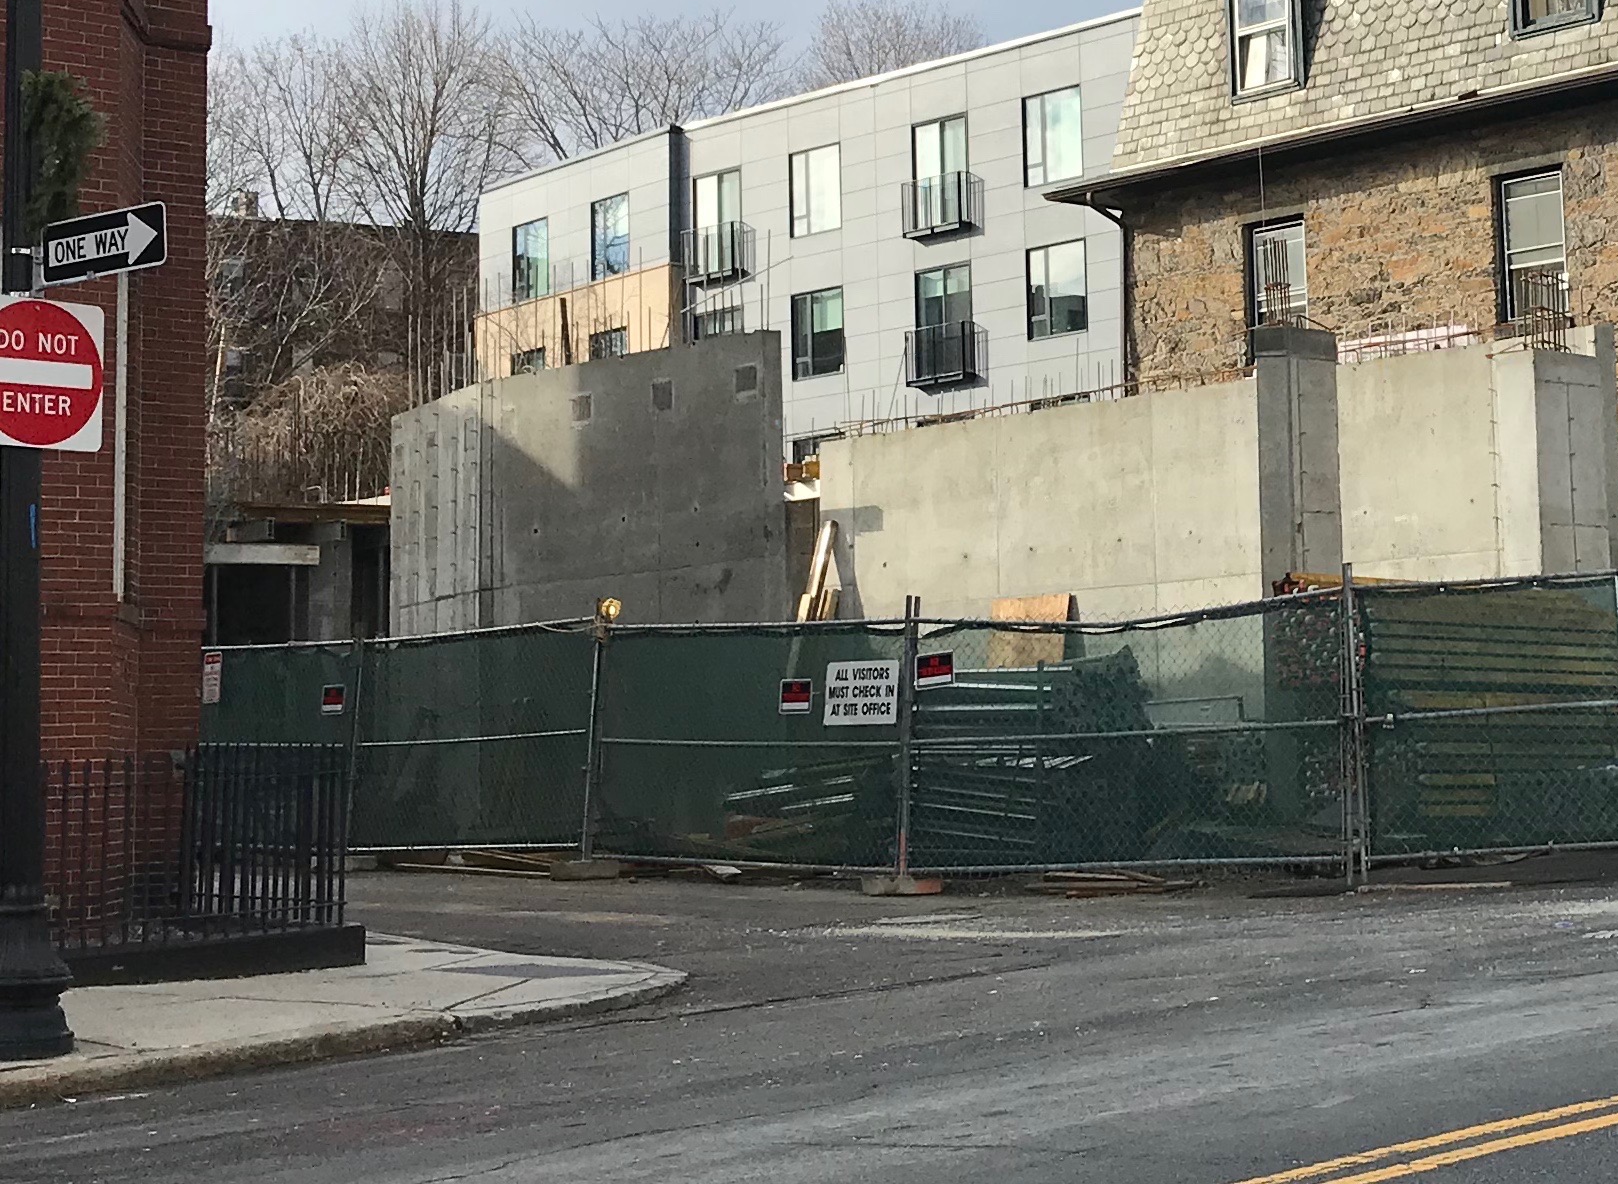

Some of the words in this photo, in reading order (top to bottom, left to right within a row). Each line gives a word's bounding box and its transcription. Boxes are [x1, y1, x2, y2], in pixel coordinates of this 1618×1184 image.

[54, 236, 87, 264] ONE
[94, 227, 129, 256] WAY
[0, 329, 25, 351] DO
[38, 333, 79, 355] NOT
[2, 391, 71, 416] ENTER
[835, 668, 848, 681] ALL
[852, 667, 890, 681] VISITORS
[828, 686, 849, 699] MUST
[852, 685, 881, 698] CHECK
[885, 684, 895, 697] IN
[830, 703, 841, 716] AT
[843, 703, 858, 716] SITE
[862, 702, 891, 716] OFFICE
